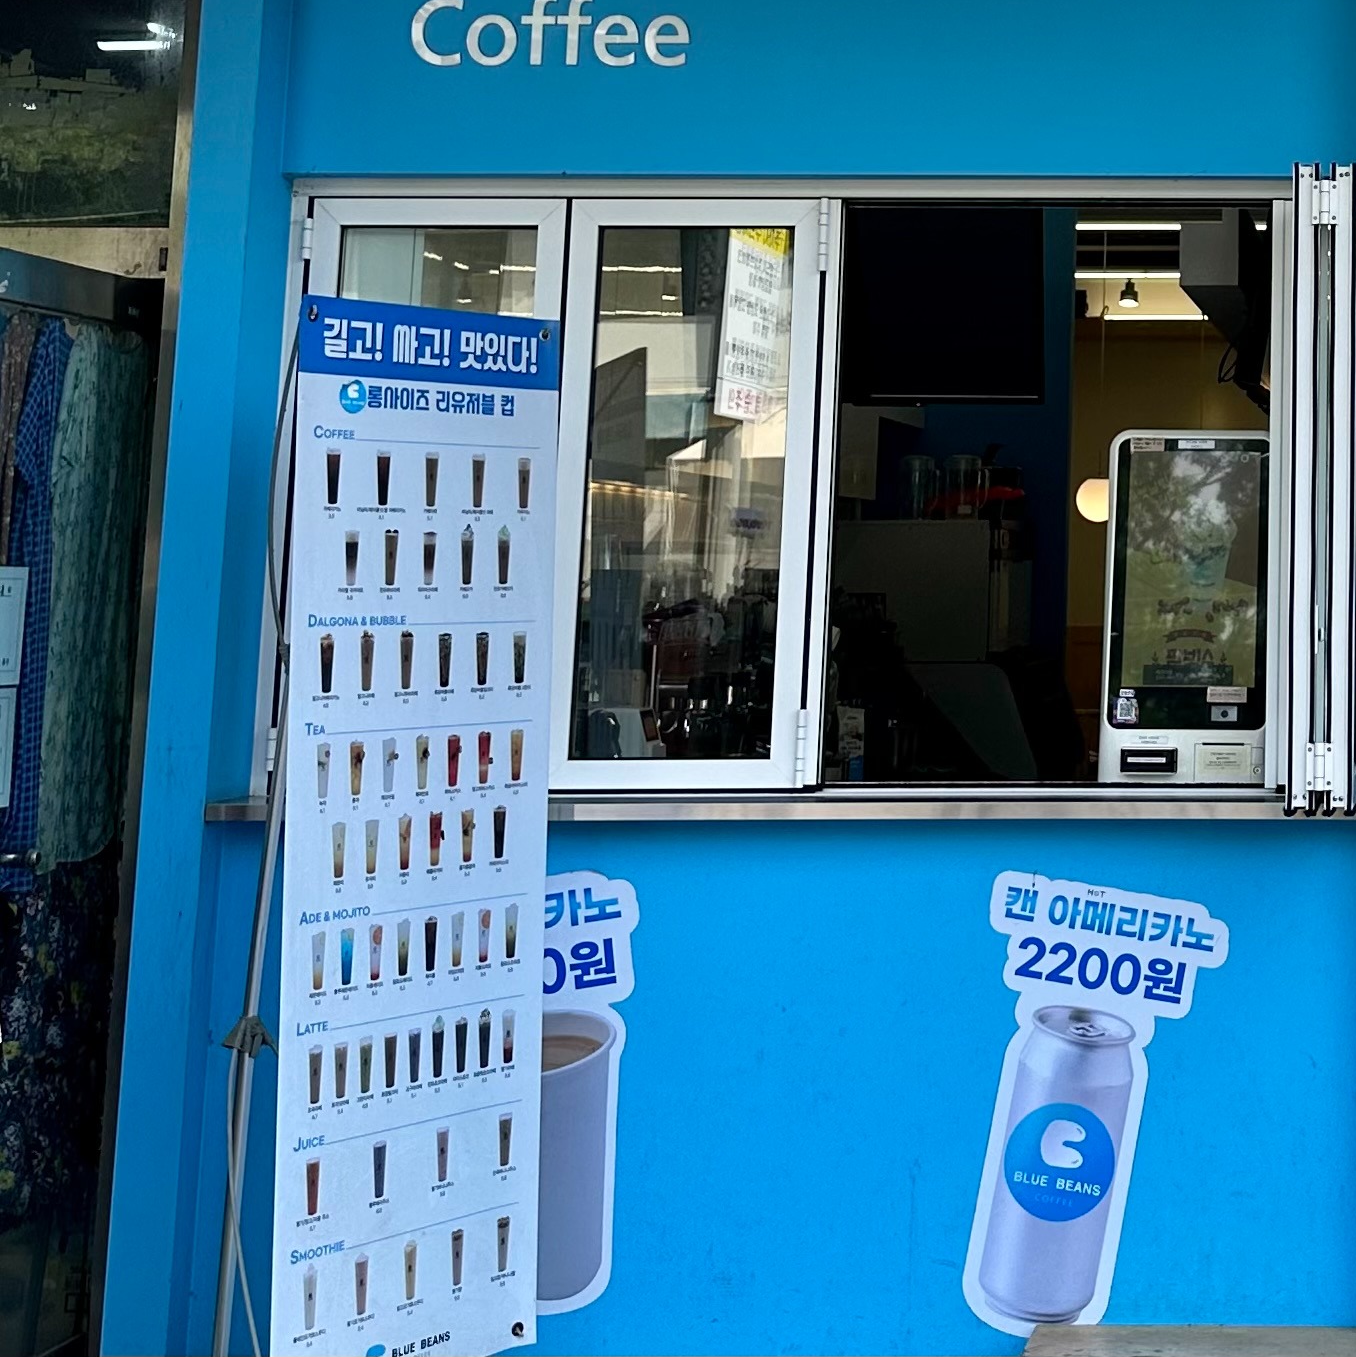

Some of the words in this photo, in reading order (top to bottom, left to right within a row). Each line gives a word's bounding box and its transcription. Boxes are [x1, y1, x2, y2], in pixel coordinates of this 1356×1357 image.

[323, 318, 382, 362] 길고!
[392, 323, 450, 367] 싸고!
[460, 331, 538, 374] 맛있다!
[368, 386, 430, 412] 롱사이즈
[436, 390, 495, 415] 리유저블
[501, 395, 514, 417] 컵
[313, 425, 355, 440] COFFEE
[308, 614, 359, 628] DALGONA
[361, 616, 368, 626] &
[370, 615, 407, 626] BUBBLE
[305, 723, 326, 736] TEA
[300, 912, 323, 925] ADE
[324, 910, 331, 921] &
[332, 906, 371, 919] MOJITO
[1004, 886, 1038, 922] 캔
[1049, 894, 1215, 953] 아메리카노
[1014, 937, 1187, 1004] 2200원
[296, 1021, 328, 1036] LATTE
[293, 1135, 325, 1152] JUICE
[1013, 1170, 1049, 1193] BLUE
[1055, 1177, 1102, 1198] BEANS
[290, 1241, 345, 1264] SMOOTHIE
[392, 1342, 416, 1357] BLUE
[420, 1331, 450, 1349] BEANS
